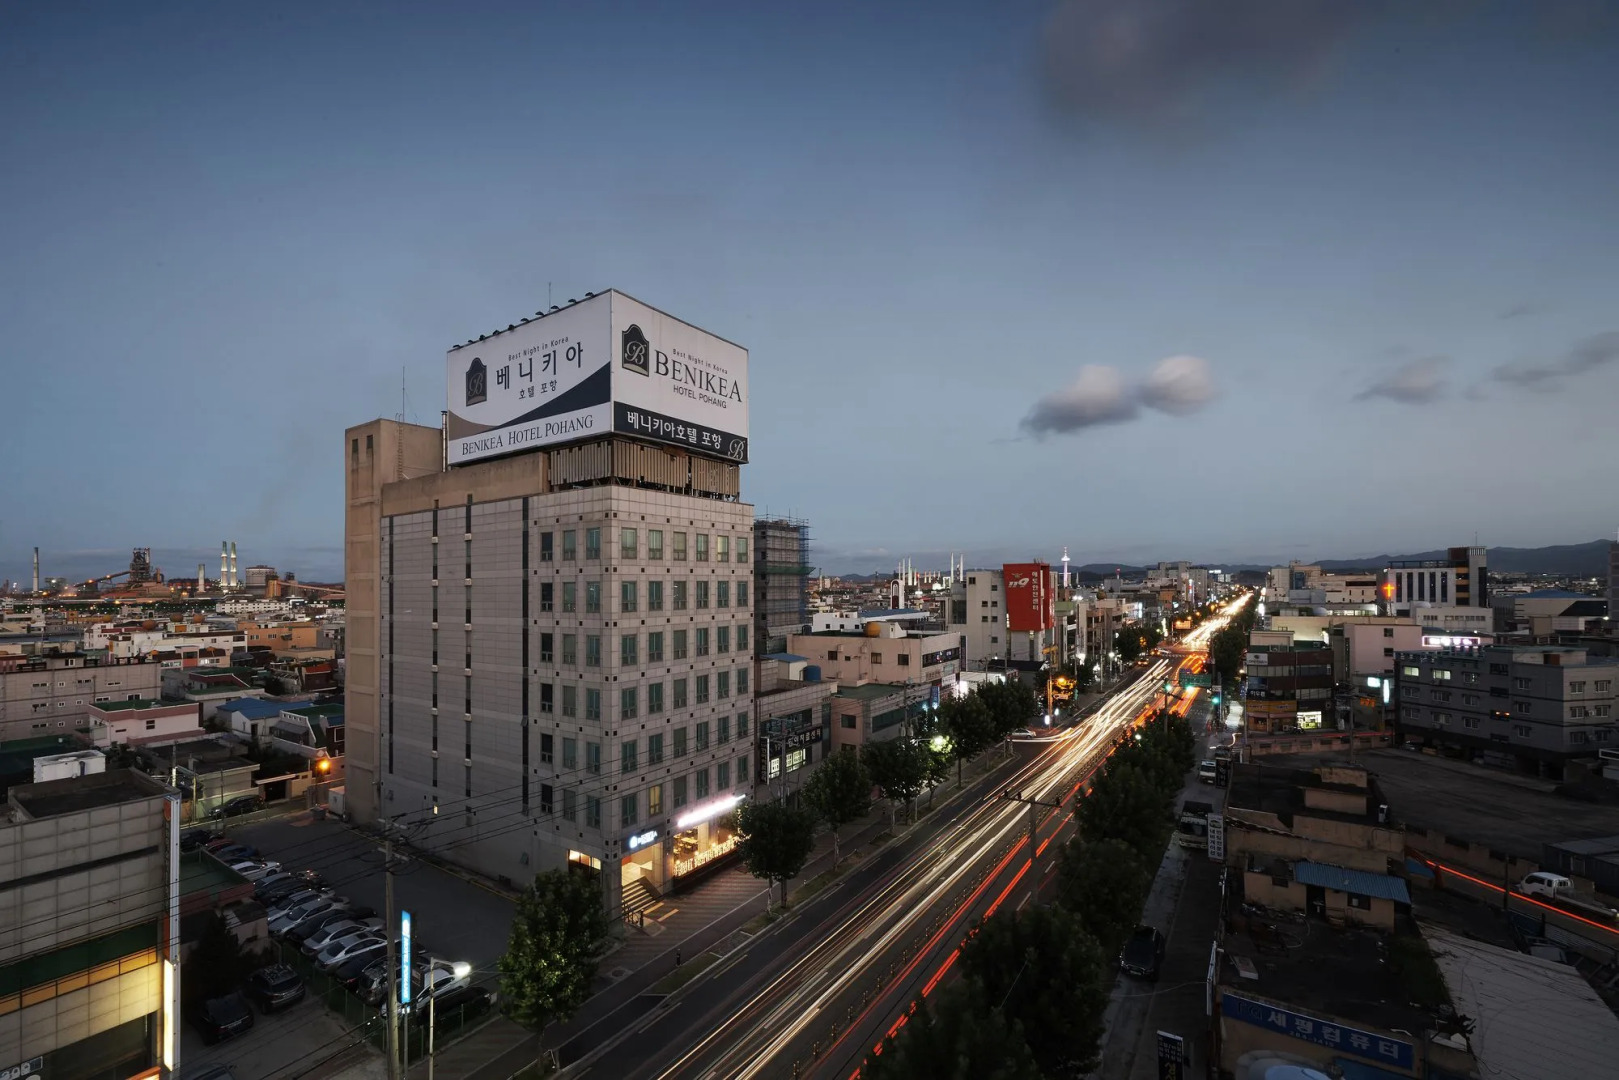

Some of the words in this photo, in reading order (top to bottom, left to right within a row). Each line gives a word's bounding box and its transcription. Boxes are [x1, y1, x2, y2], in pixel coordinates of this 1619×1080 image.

[508, 353, 521, 362] Best
[523, 345, 540, 357] Night
[542, 340, 548, 350] in
[550, 336, 568, 347] Korea
[672, 348, 686, 359] Best
[687, 354, 704, 366] Night
[705, 360, 711, 368] in
[712, 364, 728, 375] Korea
[496, 341, 584, 390] 베니키아
[655, 350, 742, 403] BENIKEA
[518, 385, 535, 400] 호텔
[540, 379, 557, 394] 포항
[673, 384, 696, 400] HOTEL
[698, 393, 727, 409] POHANG
[462, 434, 503, 456] BENIKEA
[508, 426, 543, 446] HOTEL
[545, 415, 594, 438] POHANG
[627, 411, 697, 444] 베니키아호텔
[701, 431, 722, 450] 포항
[1008, 577, 1029, 588] 119
